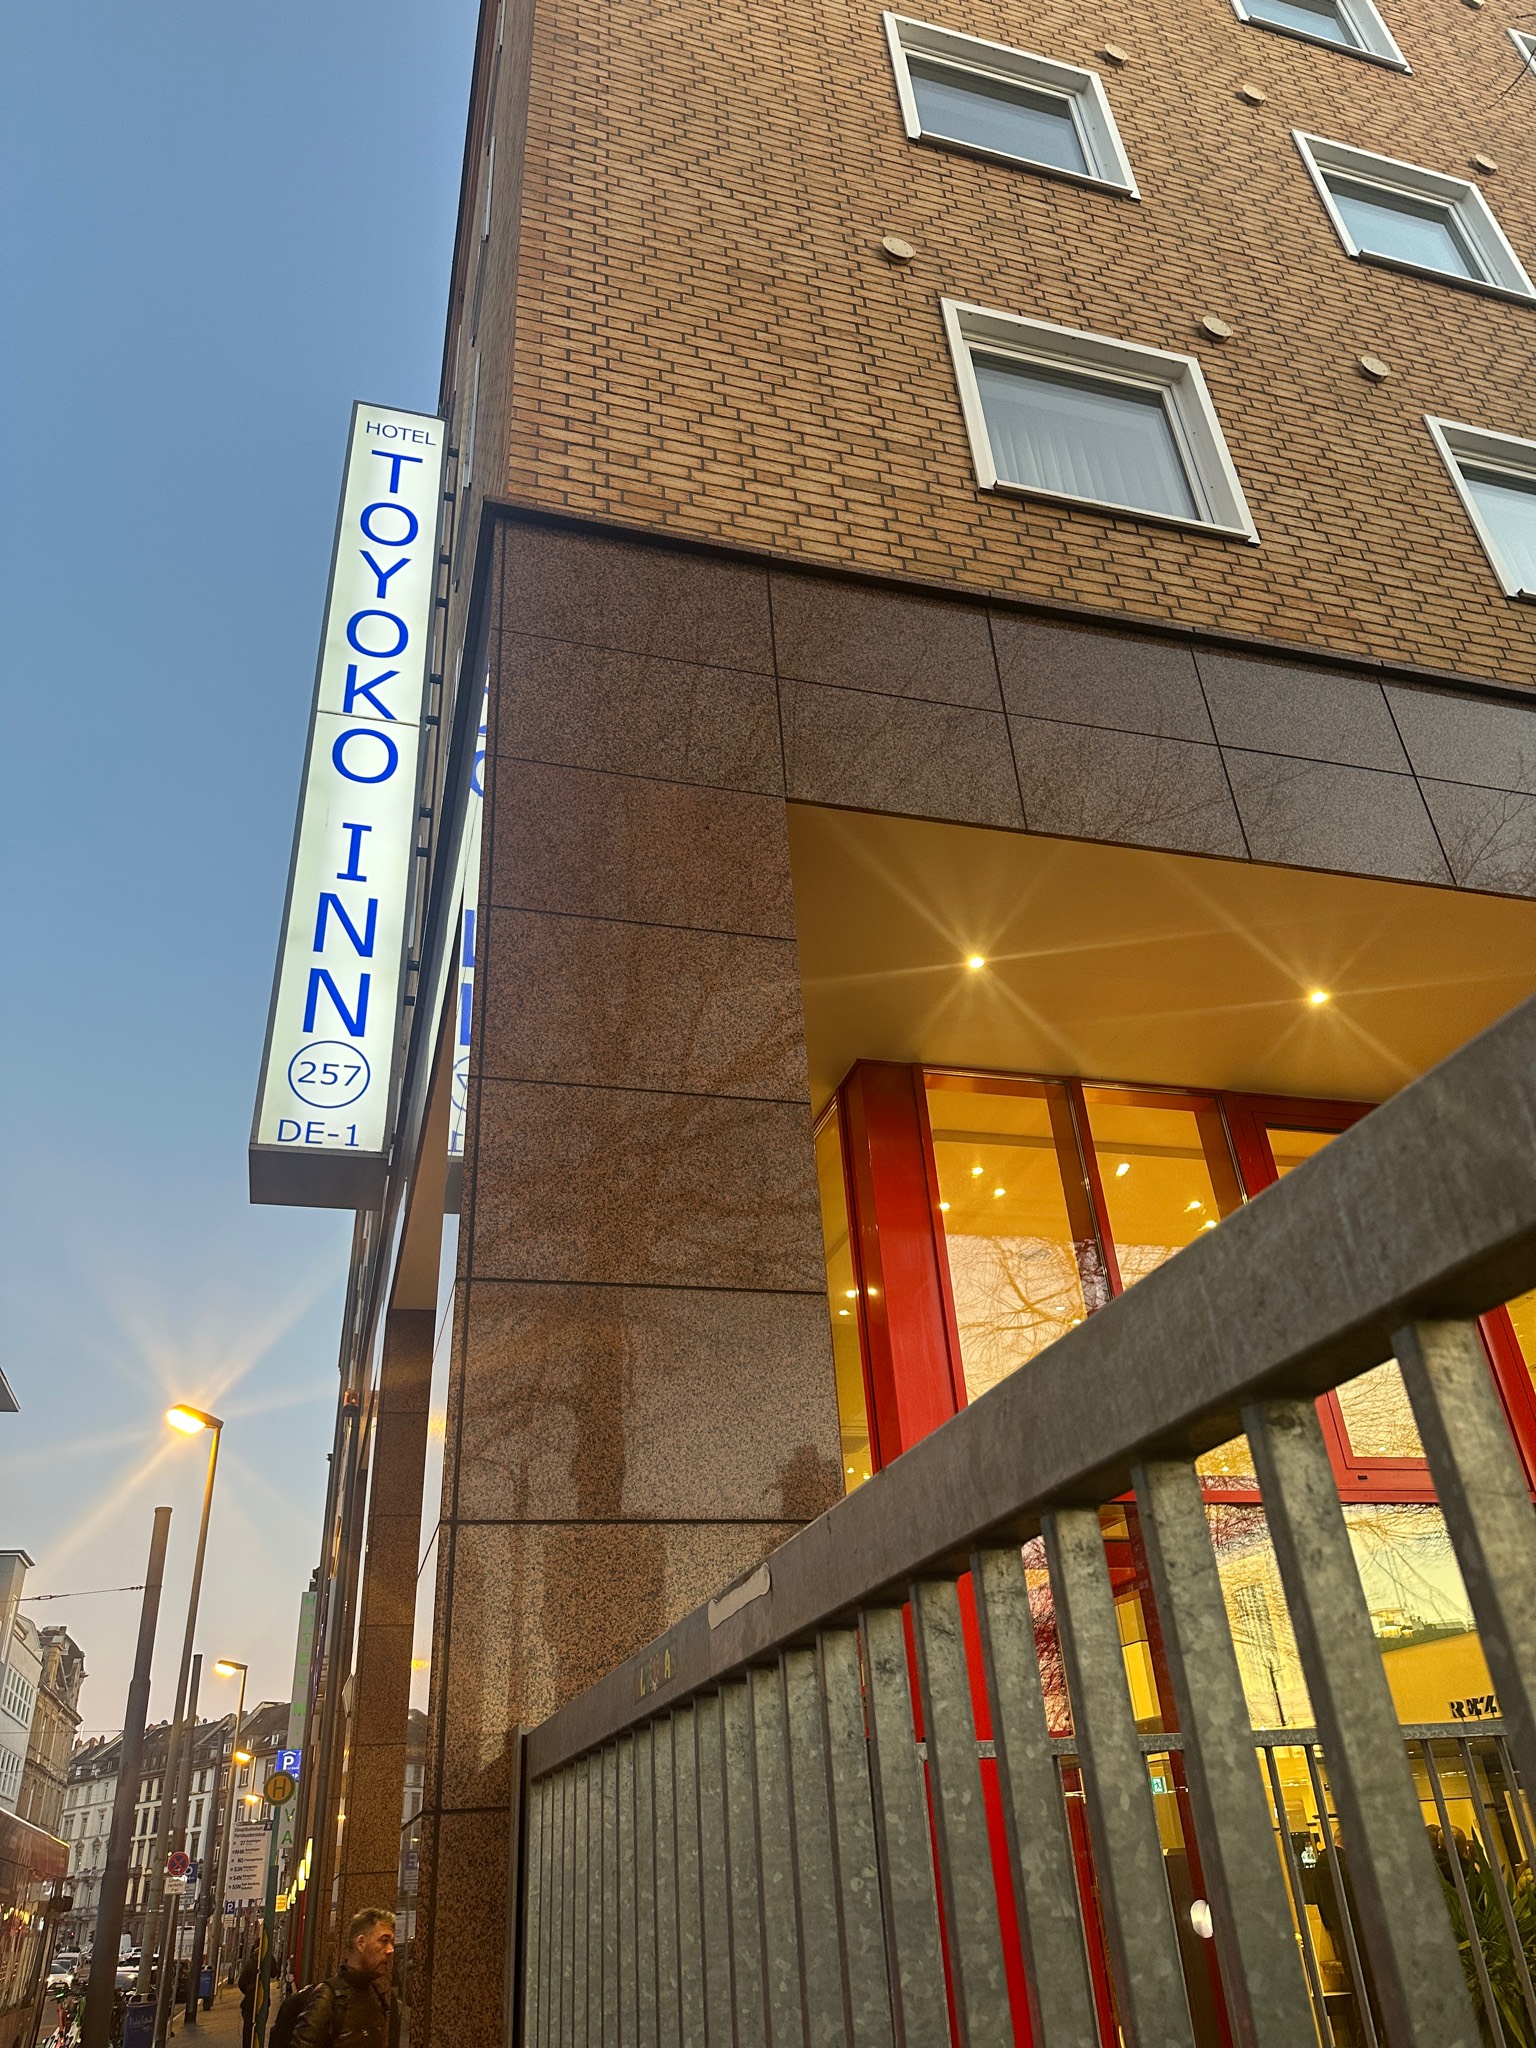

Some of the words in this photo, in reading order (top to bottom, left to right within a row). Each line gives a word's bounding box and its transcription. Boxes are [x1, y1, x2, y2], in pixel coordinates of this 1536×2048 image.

[366, 421, 436, 446] HOTEL
[332, 449, 423, 784] TOYOKO
[302, 822, 379, 1038] INN
[297, 1061, 362, 1087] 257
[277, 1119, 360, 1147] DE-1
[282, 1755, 295, 1771] P
[273, 1779, 287, 1798] H
